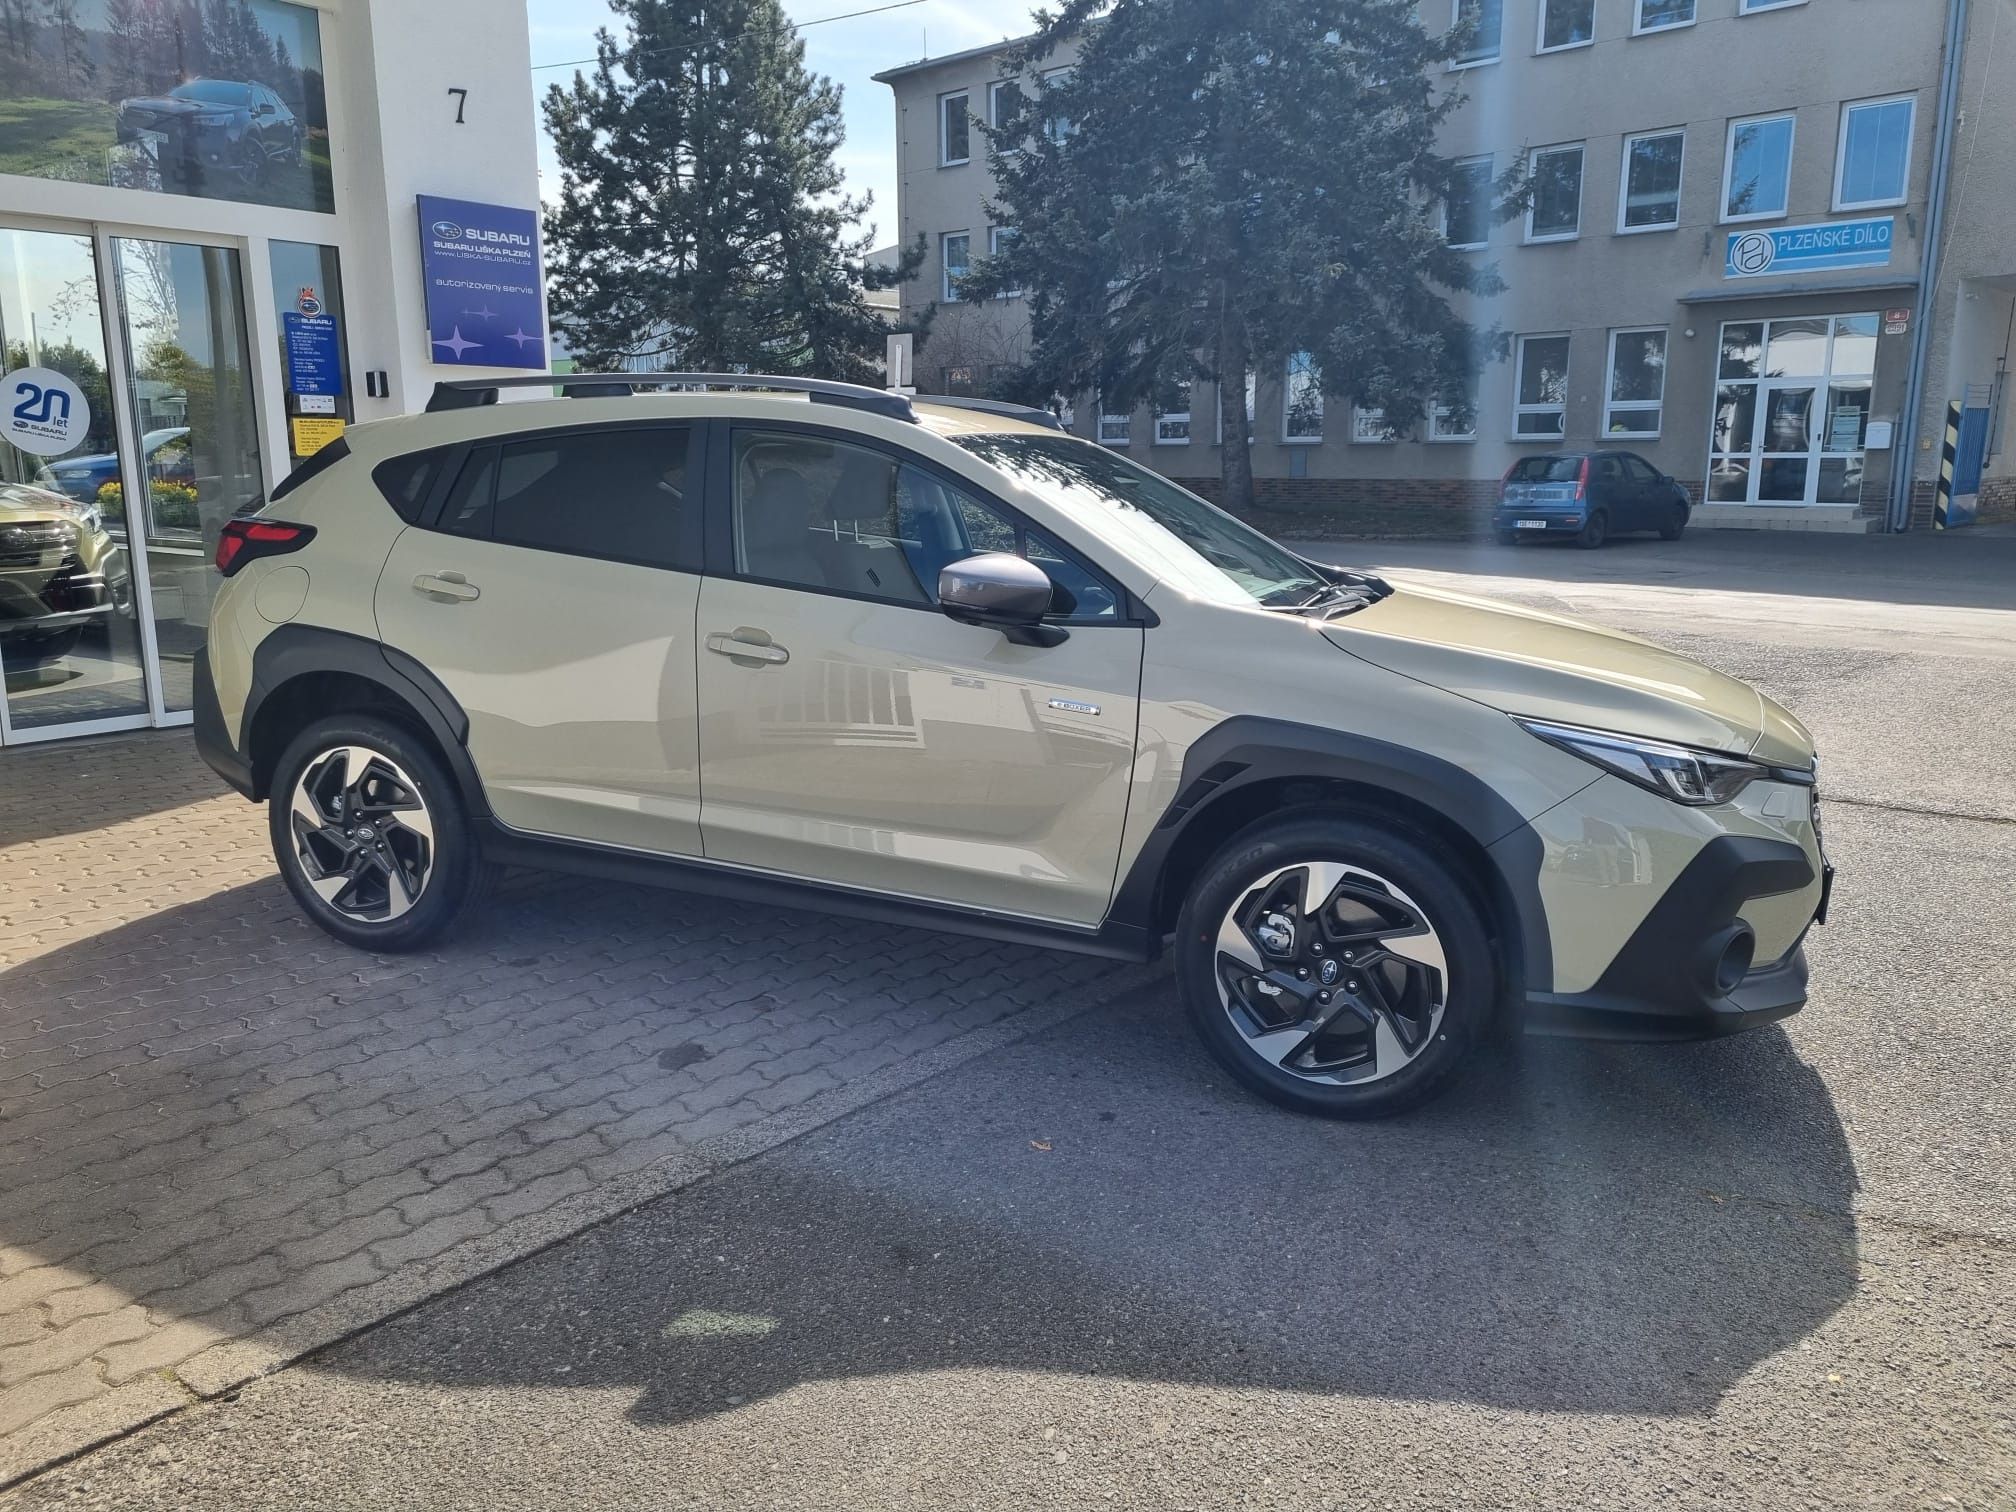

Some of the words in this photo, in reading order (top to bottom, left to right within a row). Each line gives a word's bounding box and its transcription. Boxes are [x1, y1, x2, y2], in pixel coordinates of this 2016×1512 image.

[448, 88, 467, 124] 7
[465, 228, 530, 246] SUBARU
[1778, 227, 1851, 252] PLZEŇSKÉ
[1854, 223, 1889, 245] DÍLO
[433, 240, 474, 252] SUBARU
[503, 285, 533, 294] servis
[301, 317, 332, 325] SUBARU
[52, 416, 68, 428] let
[31, 424, 67, 436] SUBARU
